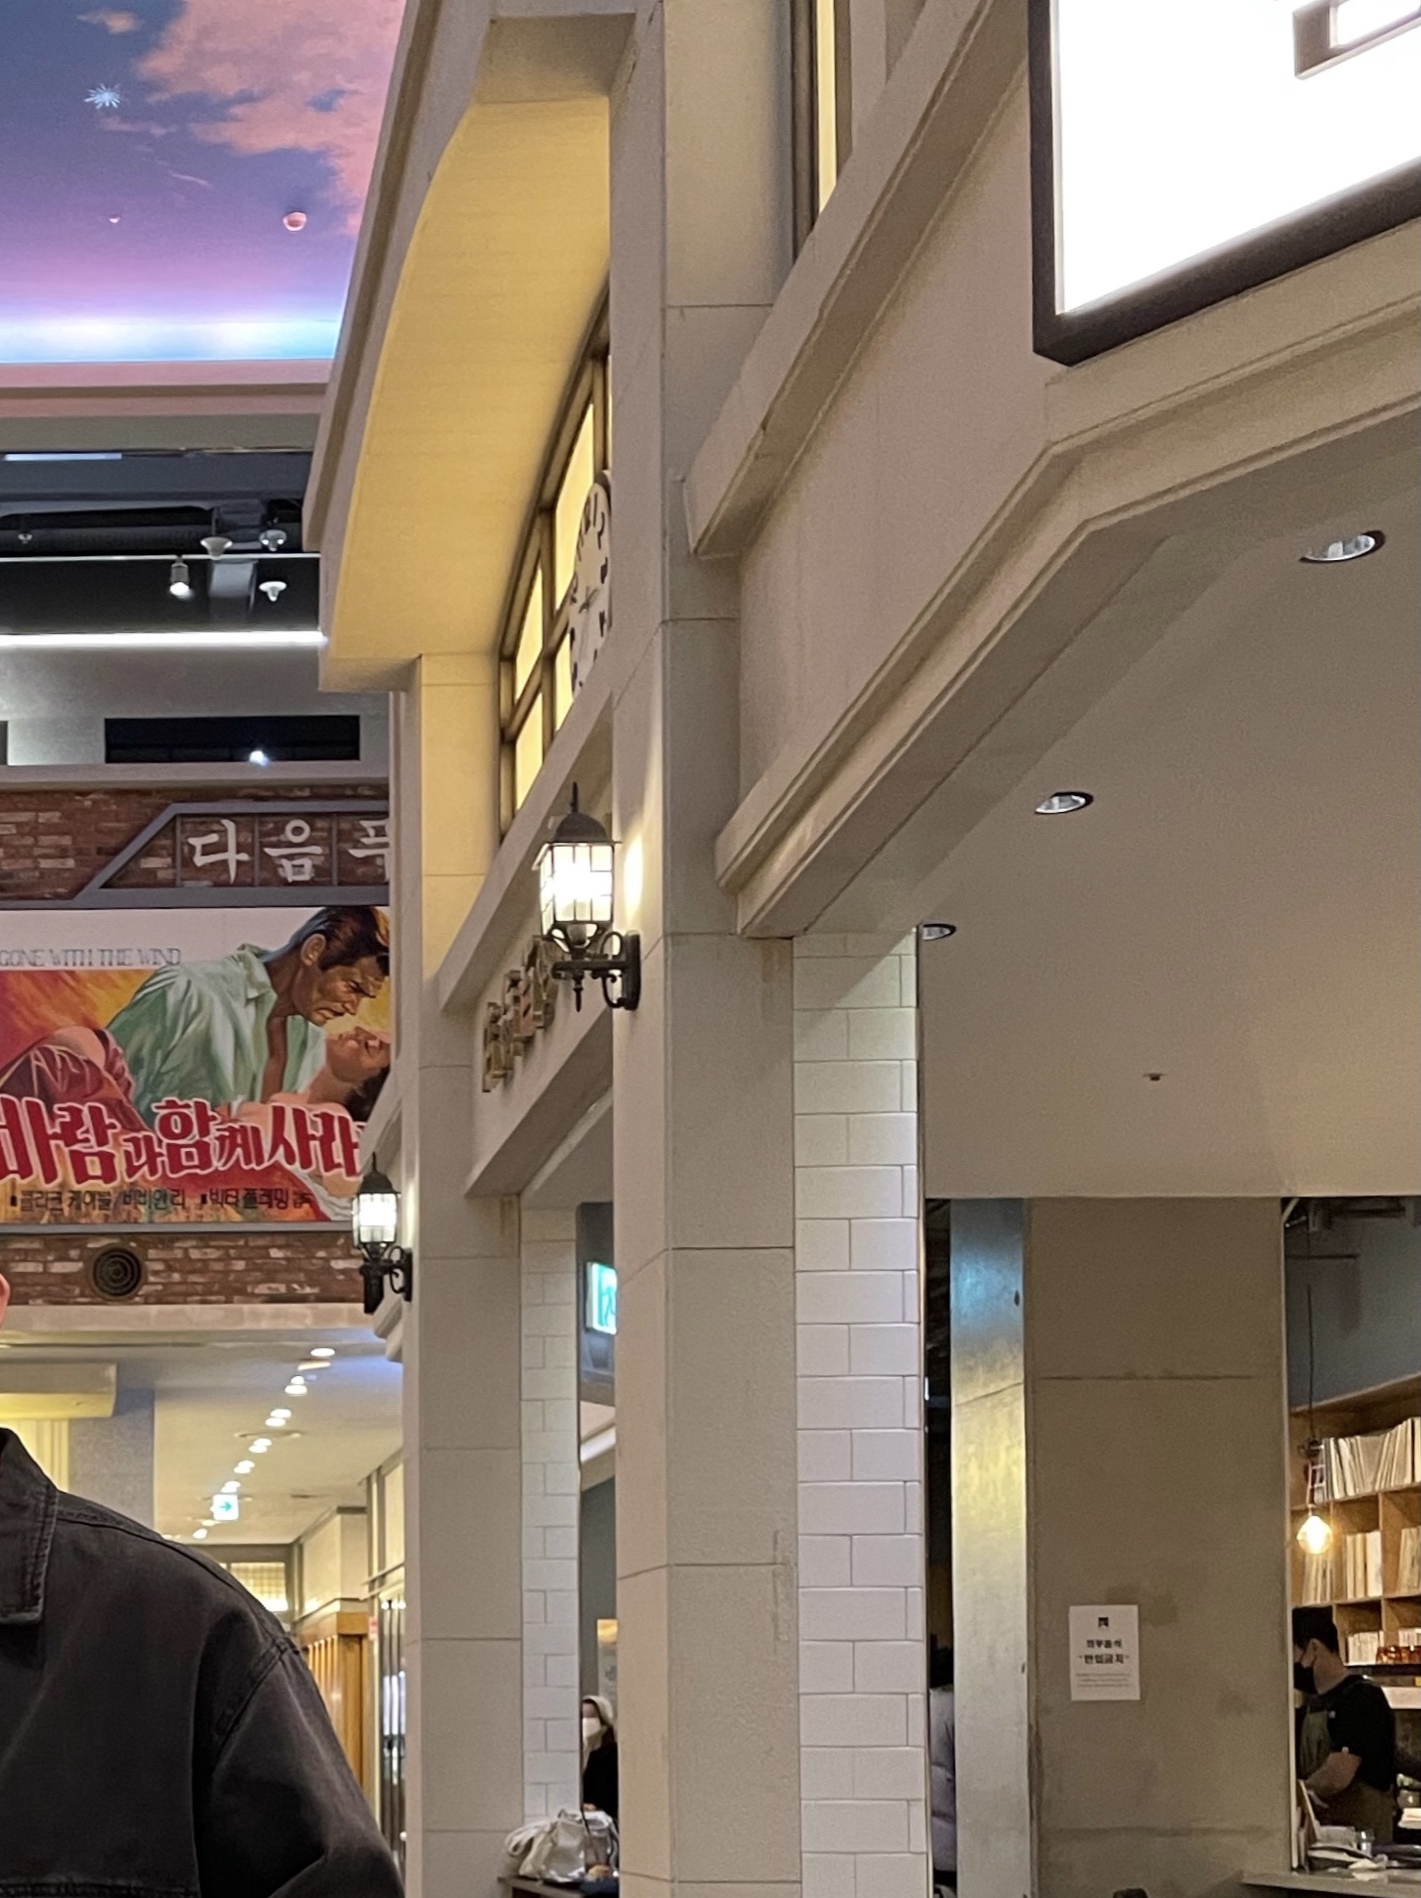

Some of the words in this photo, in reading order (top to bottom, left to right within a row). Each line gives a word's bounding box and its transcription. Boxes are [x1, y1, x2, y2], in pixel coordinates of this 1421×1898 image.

[49, 949, 93, 967] WITH
[98, 949, 135, 967] THE
[139, 948, 181, 966] WIND
[267, 1102, 368, 1180] 사라
